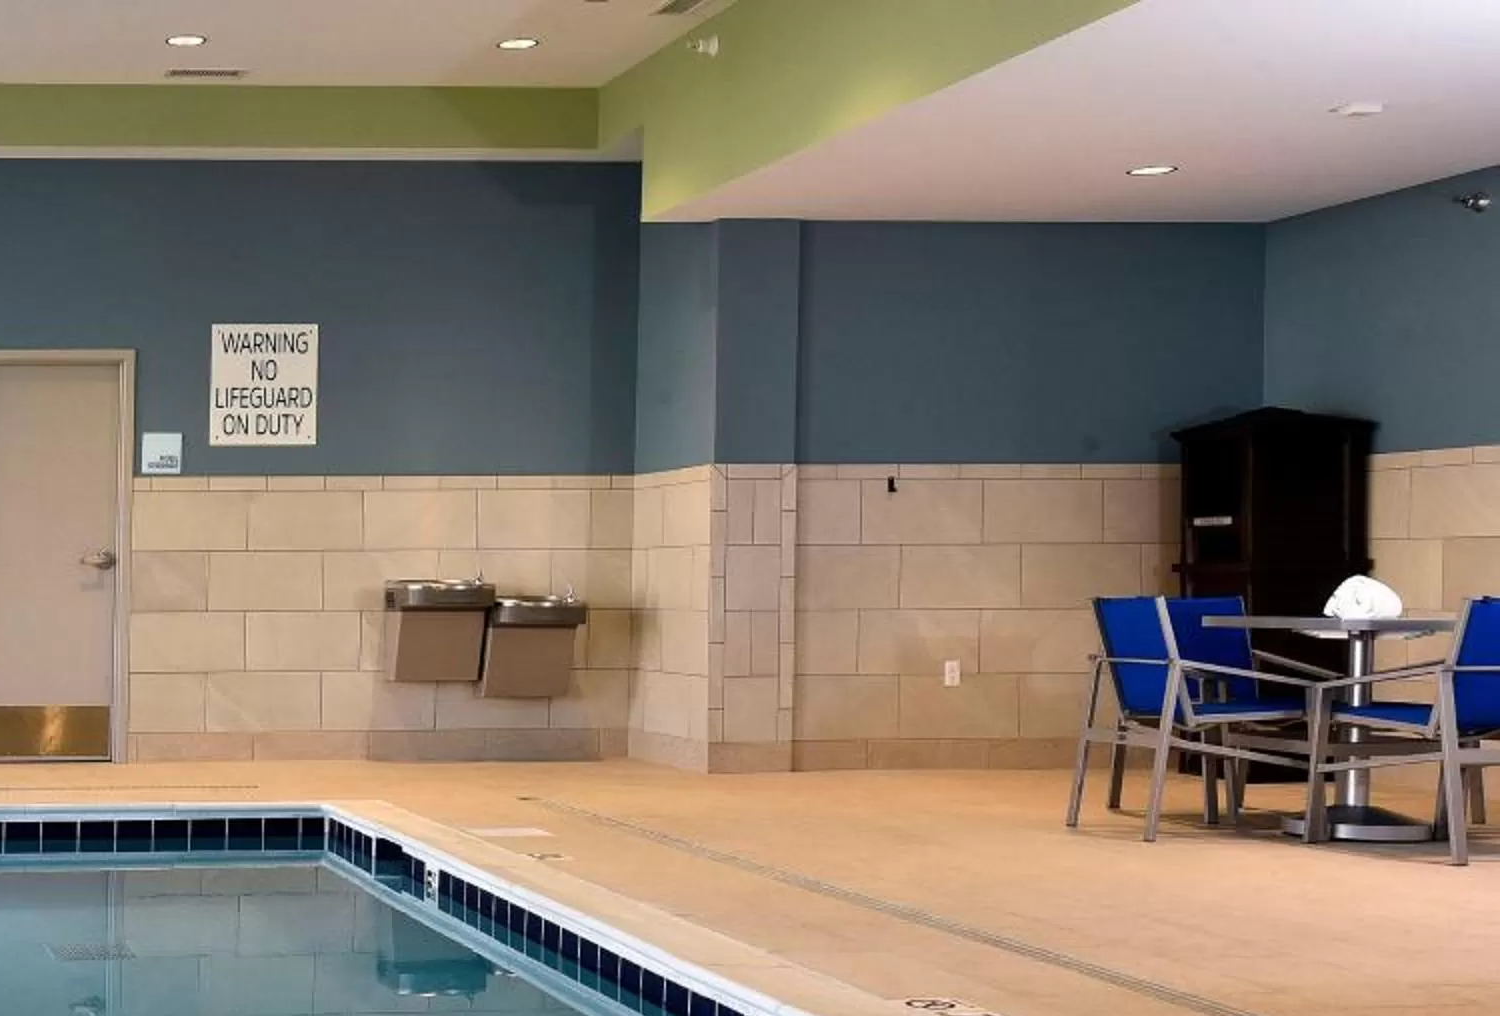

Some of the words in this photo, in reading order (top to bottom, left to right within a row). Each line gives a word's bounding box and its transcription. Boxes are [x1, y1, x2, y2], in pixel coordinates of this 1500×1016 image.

[220, 332, 309, 355] WARNING
[250, 359, 278, 382] NO
[215, 386, 313, 409] LIFEGUARD
[222, 413, 249, 436] ON
[255, 413, 305, 436] DUTY
